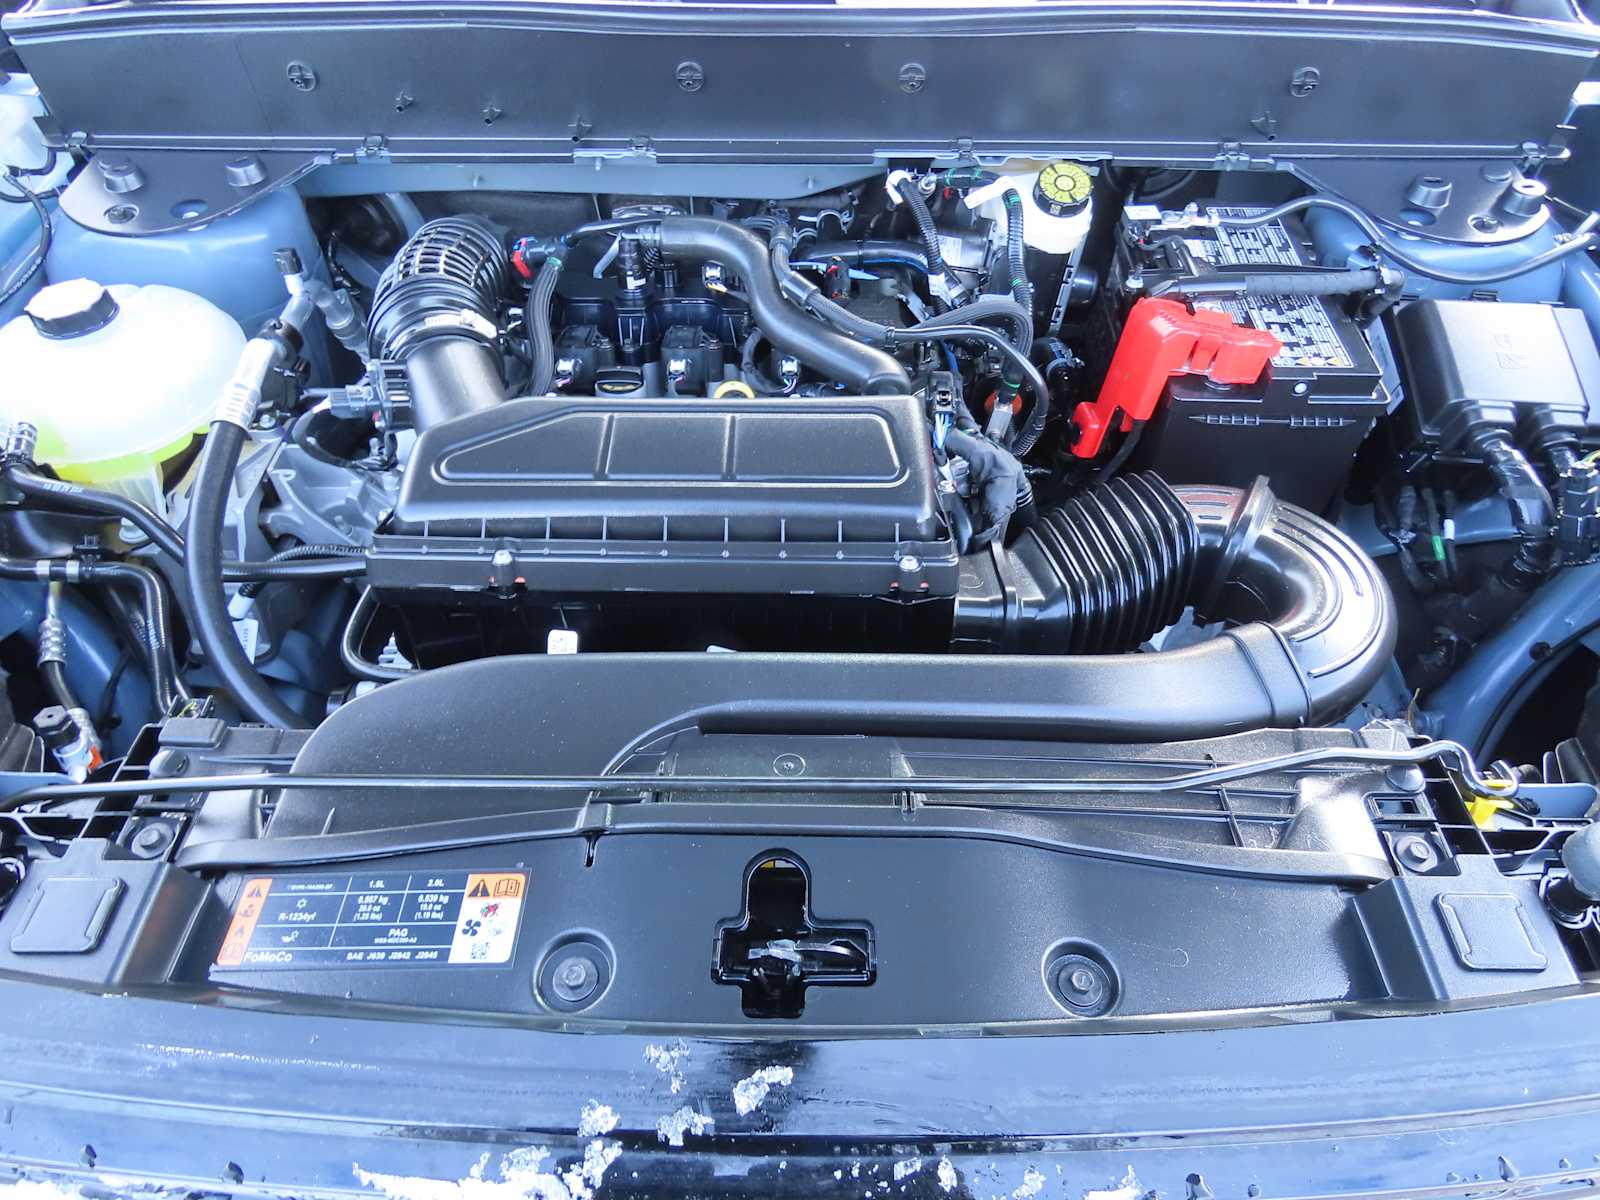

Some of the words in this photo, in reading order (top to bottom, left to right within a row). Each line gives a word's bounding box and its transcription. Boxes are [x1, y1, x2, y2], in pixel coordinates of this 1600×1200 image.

[427, 879, 444, 887] 2.0L
[379, 896, 389, 905] kg
[439, 895, 449, 904] kg
[278, 912, 317, 923] R-1234yf
[388, 928, 408, 937] PAG
[243, 951, 293, 962] FoMoCo
